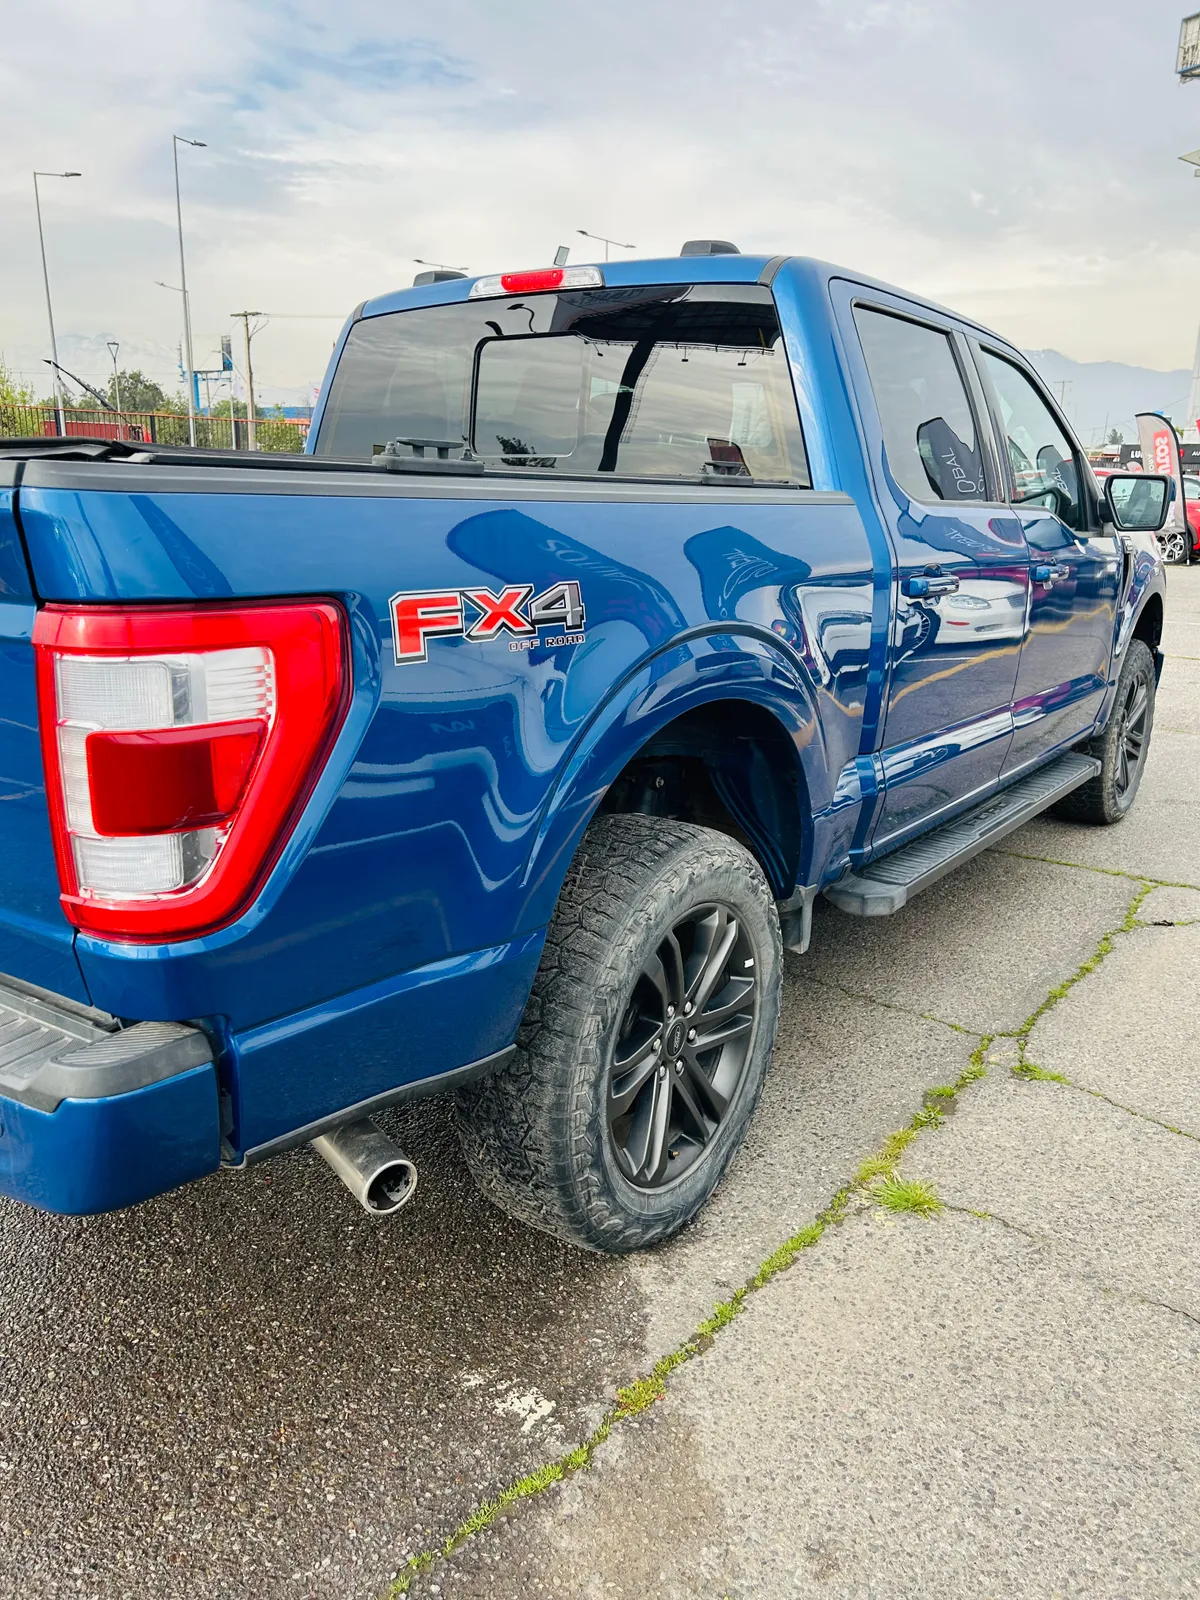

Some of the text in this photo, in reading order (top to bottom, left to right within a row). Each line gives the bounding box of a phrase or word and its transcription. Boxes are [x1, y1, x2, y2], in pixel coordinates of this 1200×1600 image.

[388, 580, 586, 667] FX4
[508, 633, 586, 652] OFF ROAD
